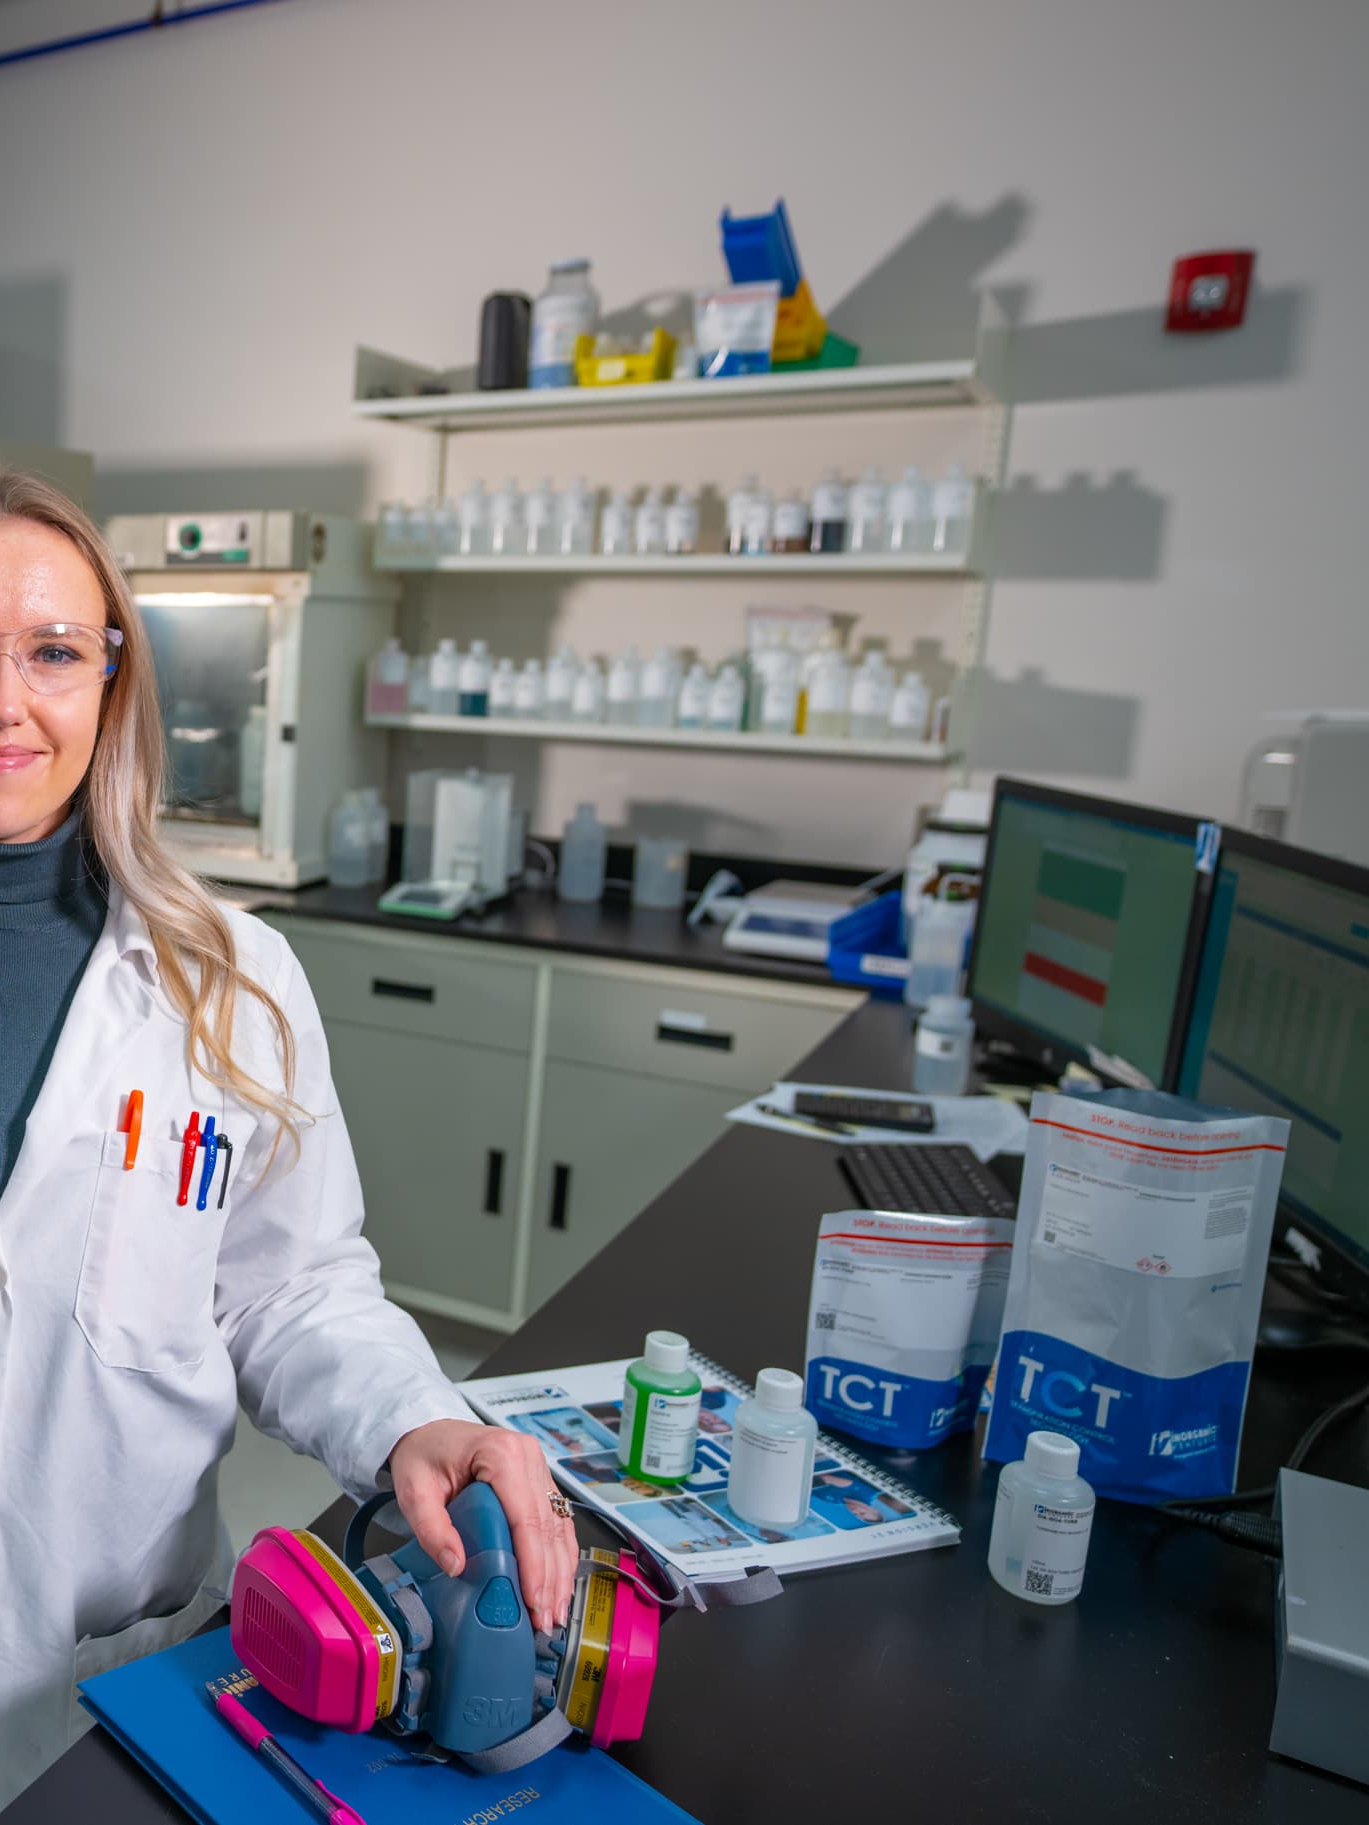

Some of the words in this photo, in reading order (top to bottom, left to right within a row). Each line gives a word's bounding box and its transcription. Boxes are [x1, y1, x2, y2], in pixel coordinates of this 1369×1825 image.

[820, 1364, 902, 1417] TCT
[1018, 1354, 1121, 1429] TCT
[462, 1695, 525, 1728] 3M
